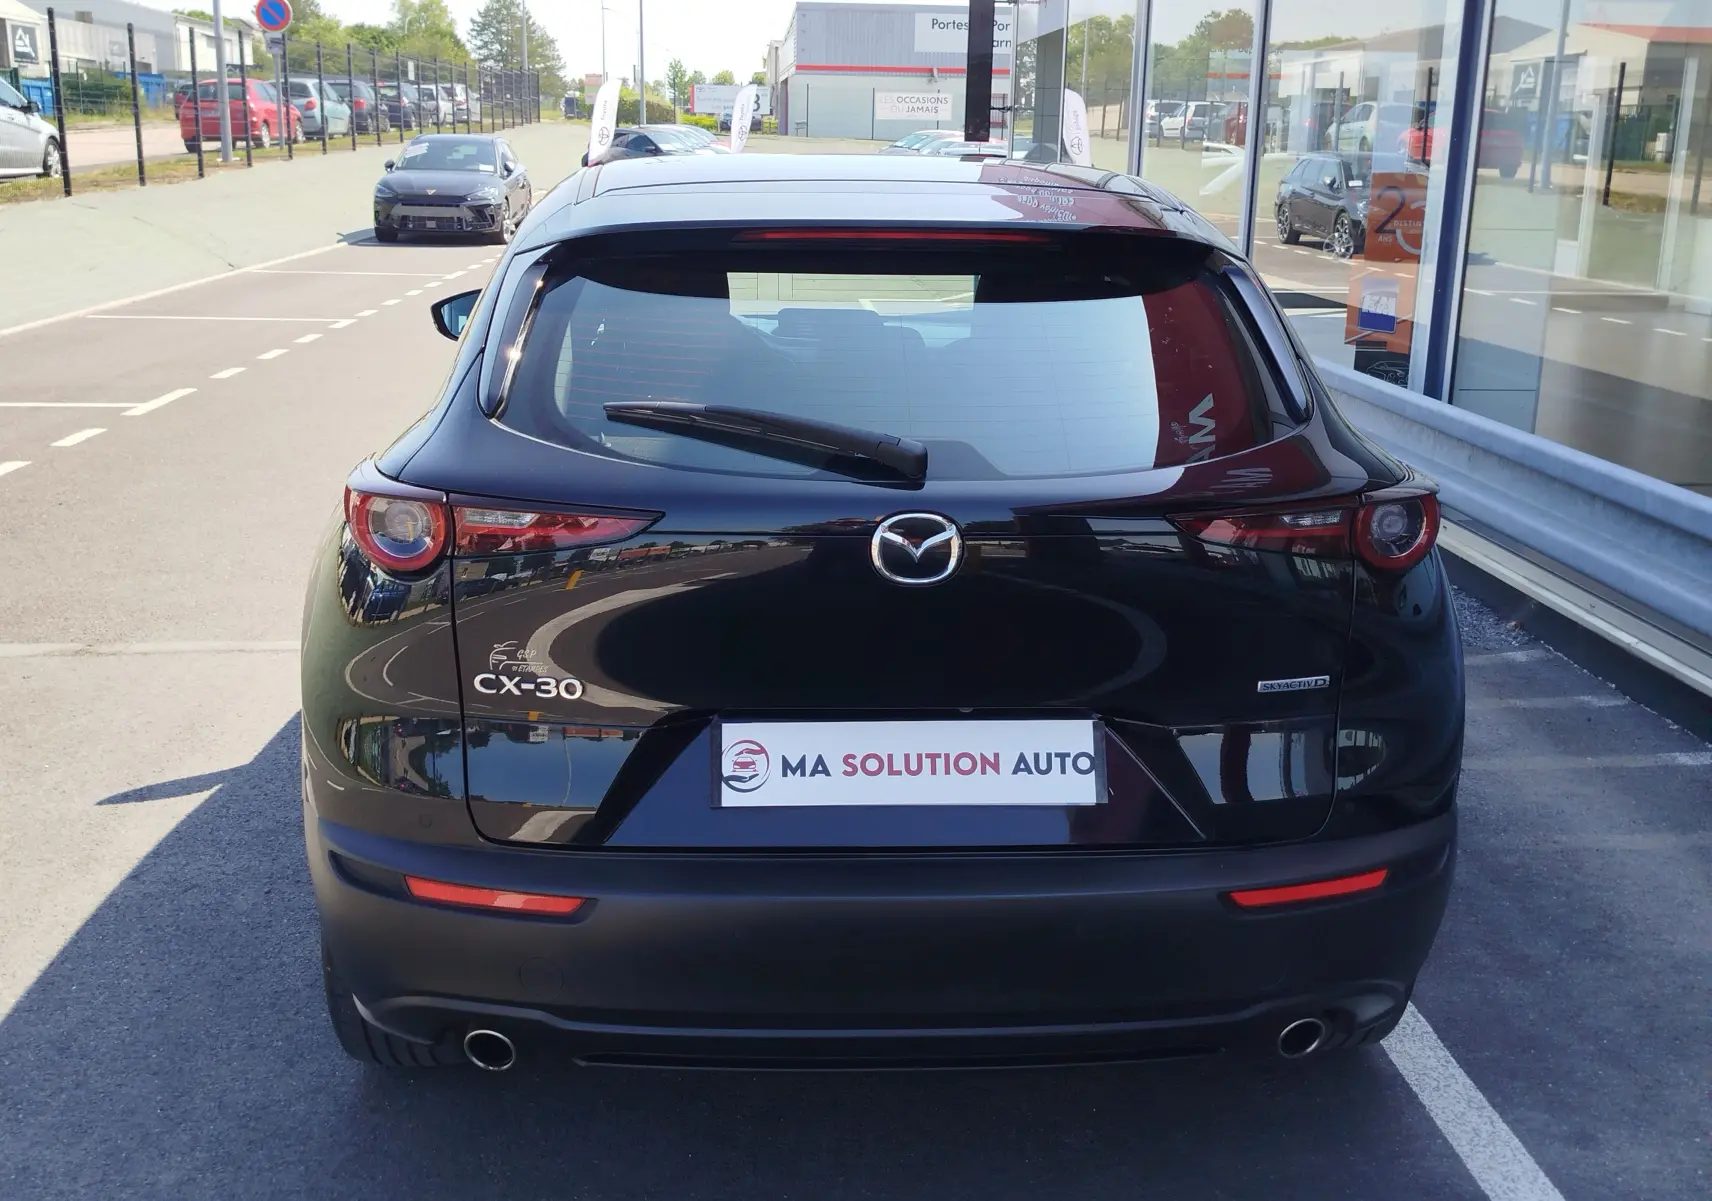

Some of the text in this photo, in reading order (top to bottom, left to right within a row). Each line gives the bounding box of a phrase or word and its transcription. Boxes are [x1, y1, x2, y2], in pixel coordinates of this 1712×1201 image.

[931, 17, 969, 31] Portes
[896, 95, 949, 105] OCCASIONS
[905, 105, 939, 114] JAMAIS
[473, 673, 584, 700] CX-30
[780, 751, 1096, 778] MA SOLUTION AUTO
